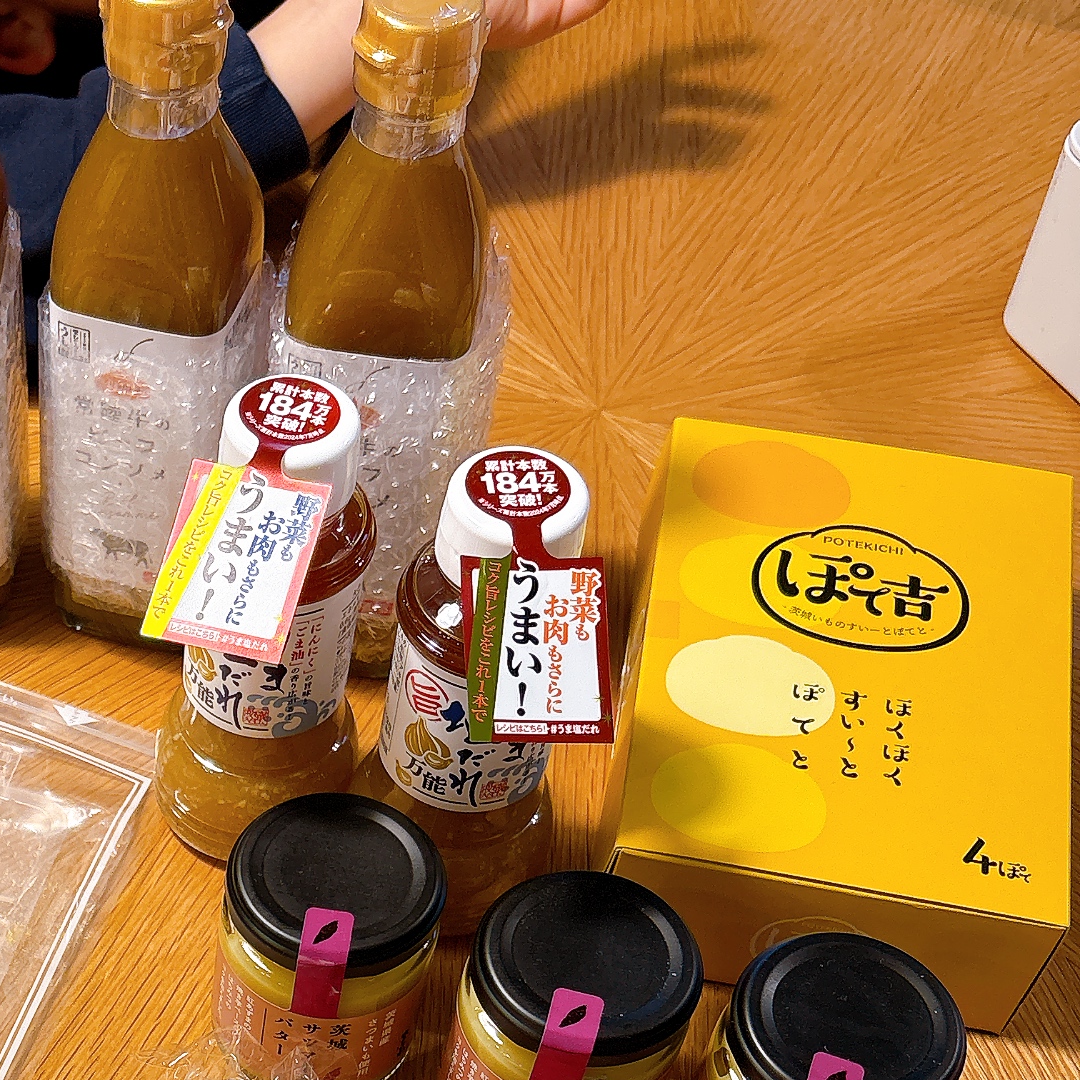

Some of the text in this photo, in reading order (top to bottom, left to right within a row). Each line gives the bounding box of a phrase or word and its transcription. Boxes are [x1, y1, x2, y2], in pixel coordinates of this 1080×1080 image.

[270, 381, 331, 404] 累計本数
[263, 413, 306, 432] 突破!
[485, 459, 548, 472] 累計本数
[281, 494, 322, 562] 野菜も
[499, 493, 543, 507] 突破!
[195, 470, 266, 620] うまい!
[225, 511, 284, 625] お肉もさらに
[823, 535, 904, 555] POTEKICHI
[569, 570, 600, 640] 野菜も
[777, 549, 950, 622] ぽて吉
[471, 561, 502, 723] コク旨レシピをこれ1本で
[506, 558, 543, 718] うまい!
[542, 594, 571, 714] お肉もさらに
[550, 723, 600, 735] #うま塩だれ
[791, 682, 826, 771] ぽてと
[882, 697, 913, 787] ほくほく
[402, 751, 448, 796] 万能
[962, 836, 1032, 884] 4ぽて
[273, 1018, 294, 1056] バター
[327, 1023, 353, 1050] 茨城
